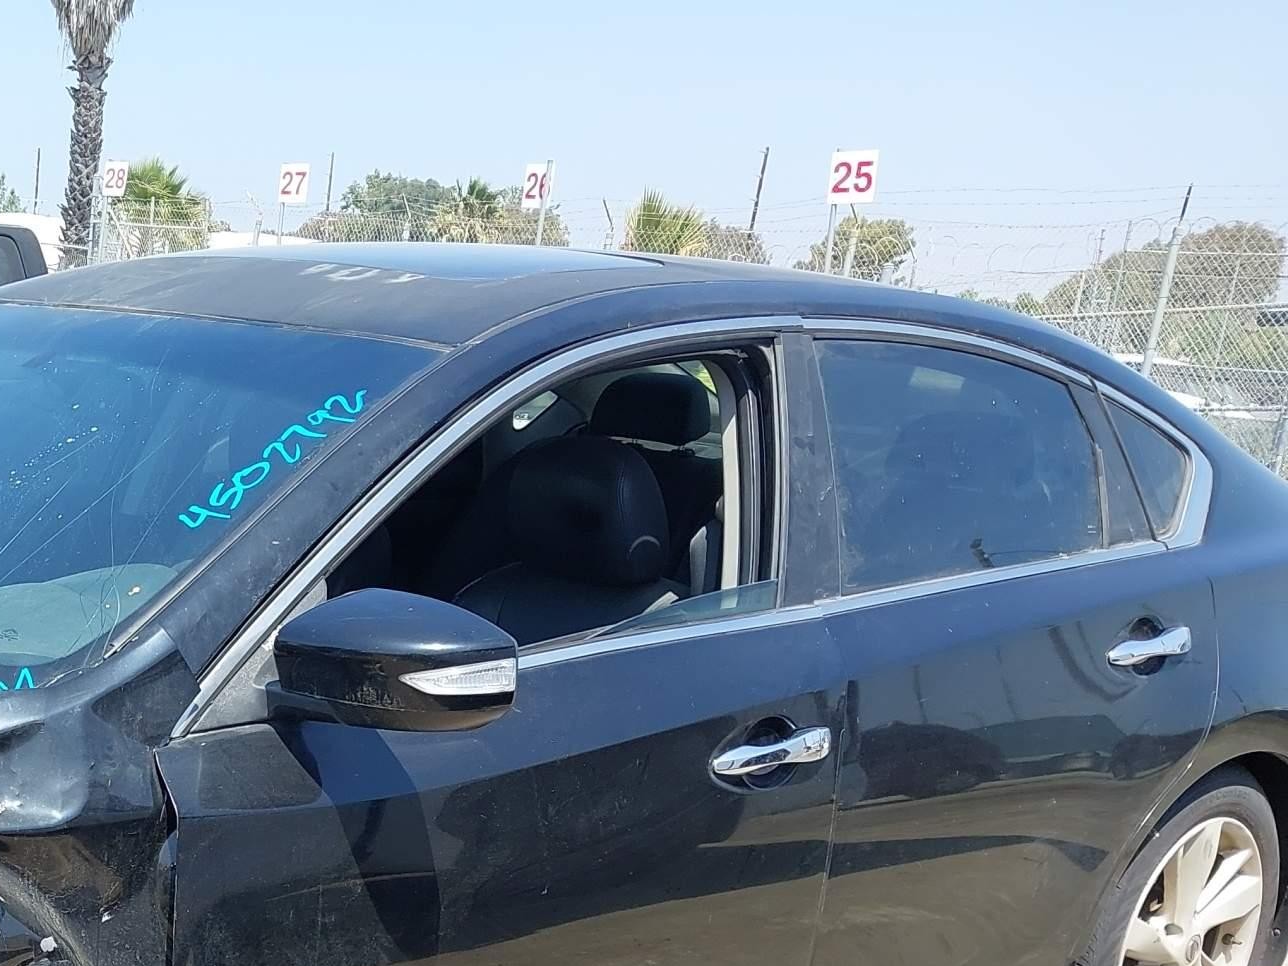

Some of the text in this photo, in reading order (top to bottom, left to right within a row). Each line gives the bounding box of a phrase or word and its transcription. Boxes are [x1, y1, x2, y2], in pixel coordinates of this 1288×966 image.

[104, 167, 126, 189] 28
[280, 171, 307, 195] 27
[831, 160, 874, 193] 25
[178, 389, 368, 528] 4502792
